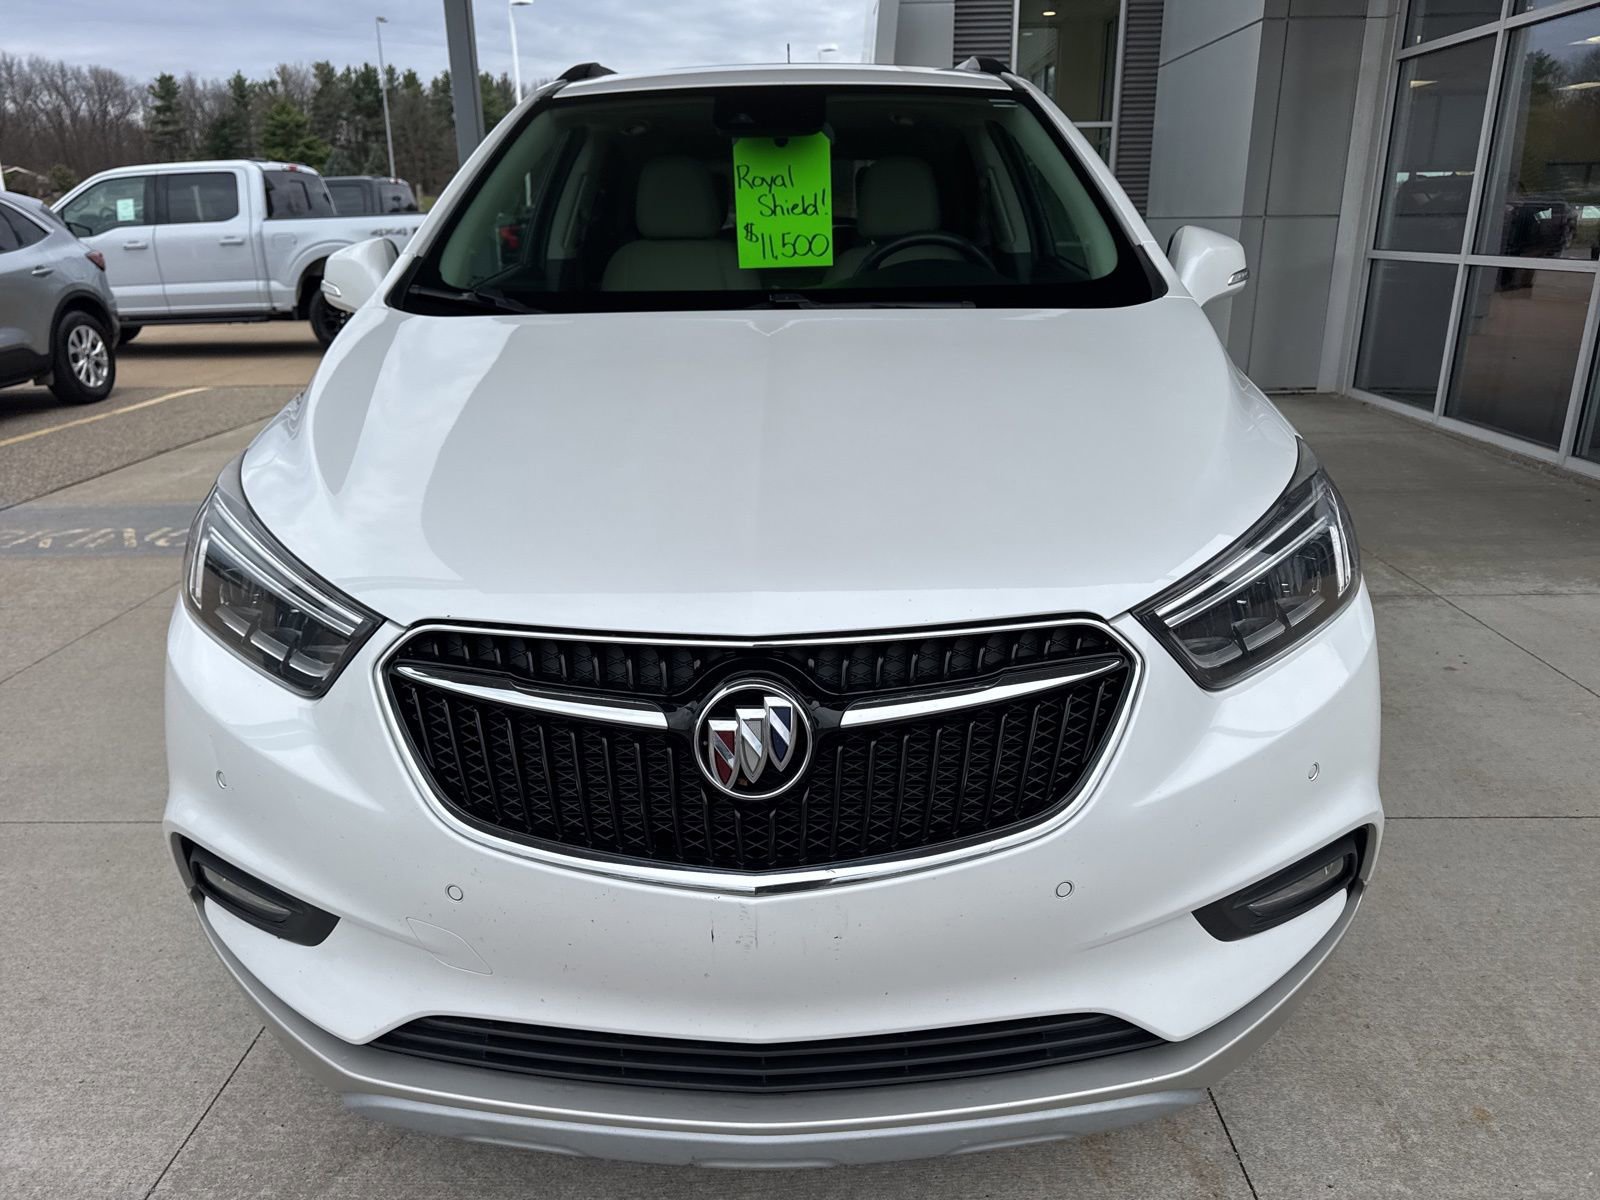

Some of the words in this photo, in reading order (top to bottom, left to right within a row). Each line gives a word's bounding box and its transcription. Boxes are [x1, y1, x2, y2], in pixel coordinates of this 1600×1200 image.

[736, 164, 795, 193] Royal
[757, 188, 829, 217] Shield!
[743, 222, 830, 260] $11,500
